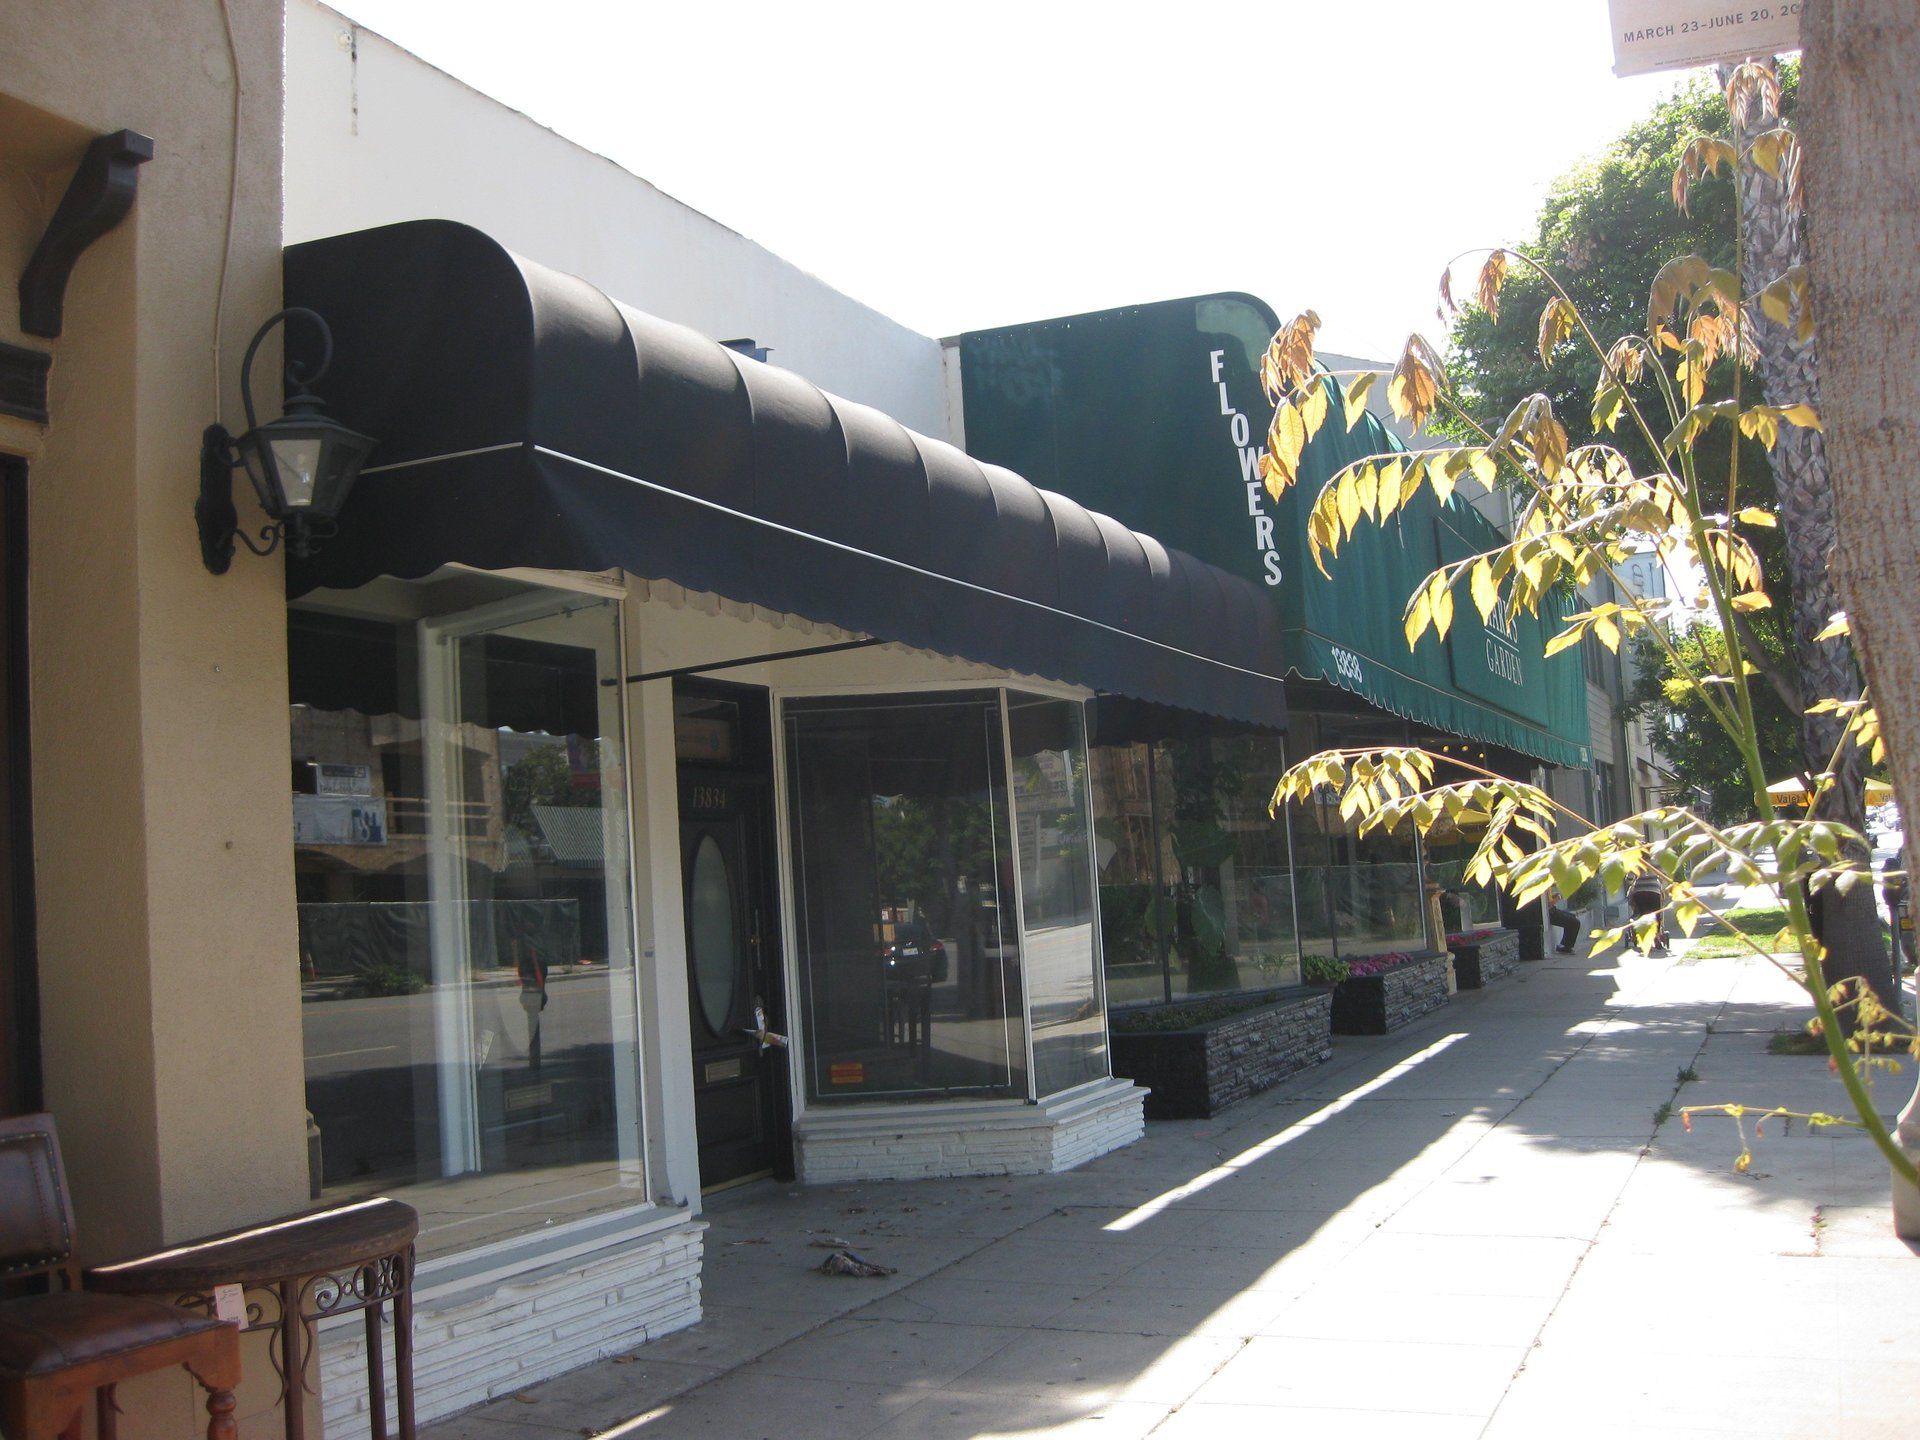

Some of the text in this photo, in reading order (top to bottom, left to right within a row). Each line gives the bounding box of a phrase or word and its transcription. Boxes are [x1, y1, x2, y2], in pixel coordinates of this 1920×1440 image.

[1623, 25, 1674, 43] MARCH
[1750, 8, 1774, 22] 20,
[1210, 349, 1283, 586] FLOWERS
[1331, 646, 1363, 684] 13838
[1486, 638, 1523, 687] GARDEN
[1776, 793, 1801, 803] Valet
